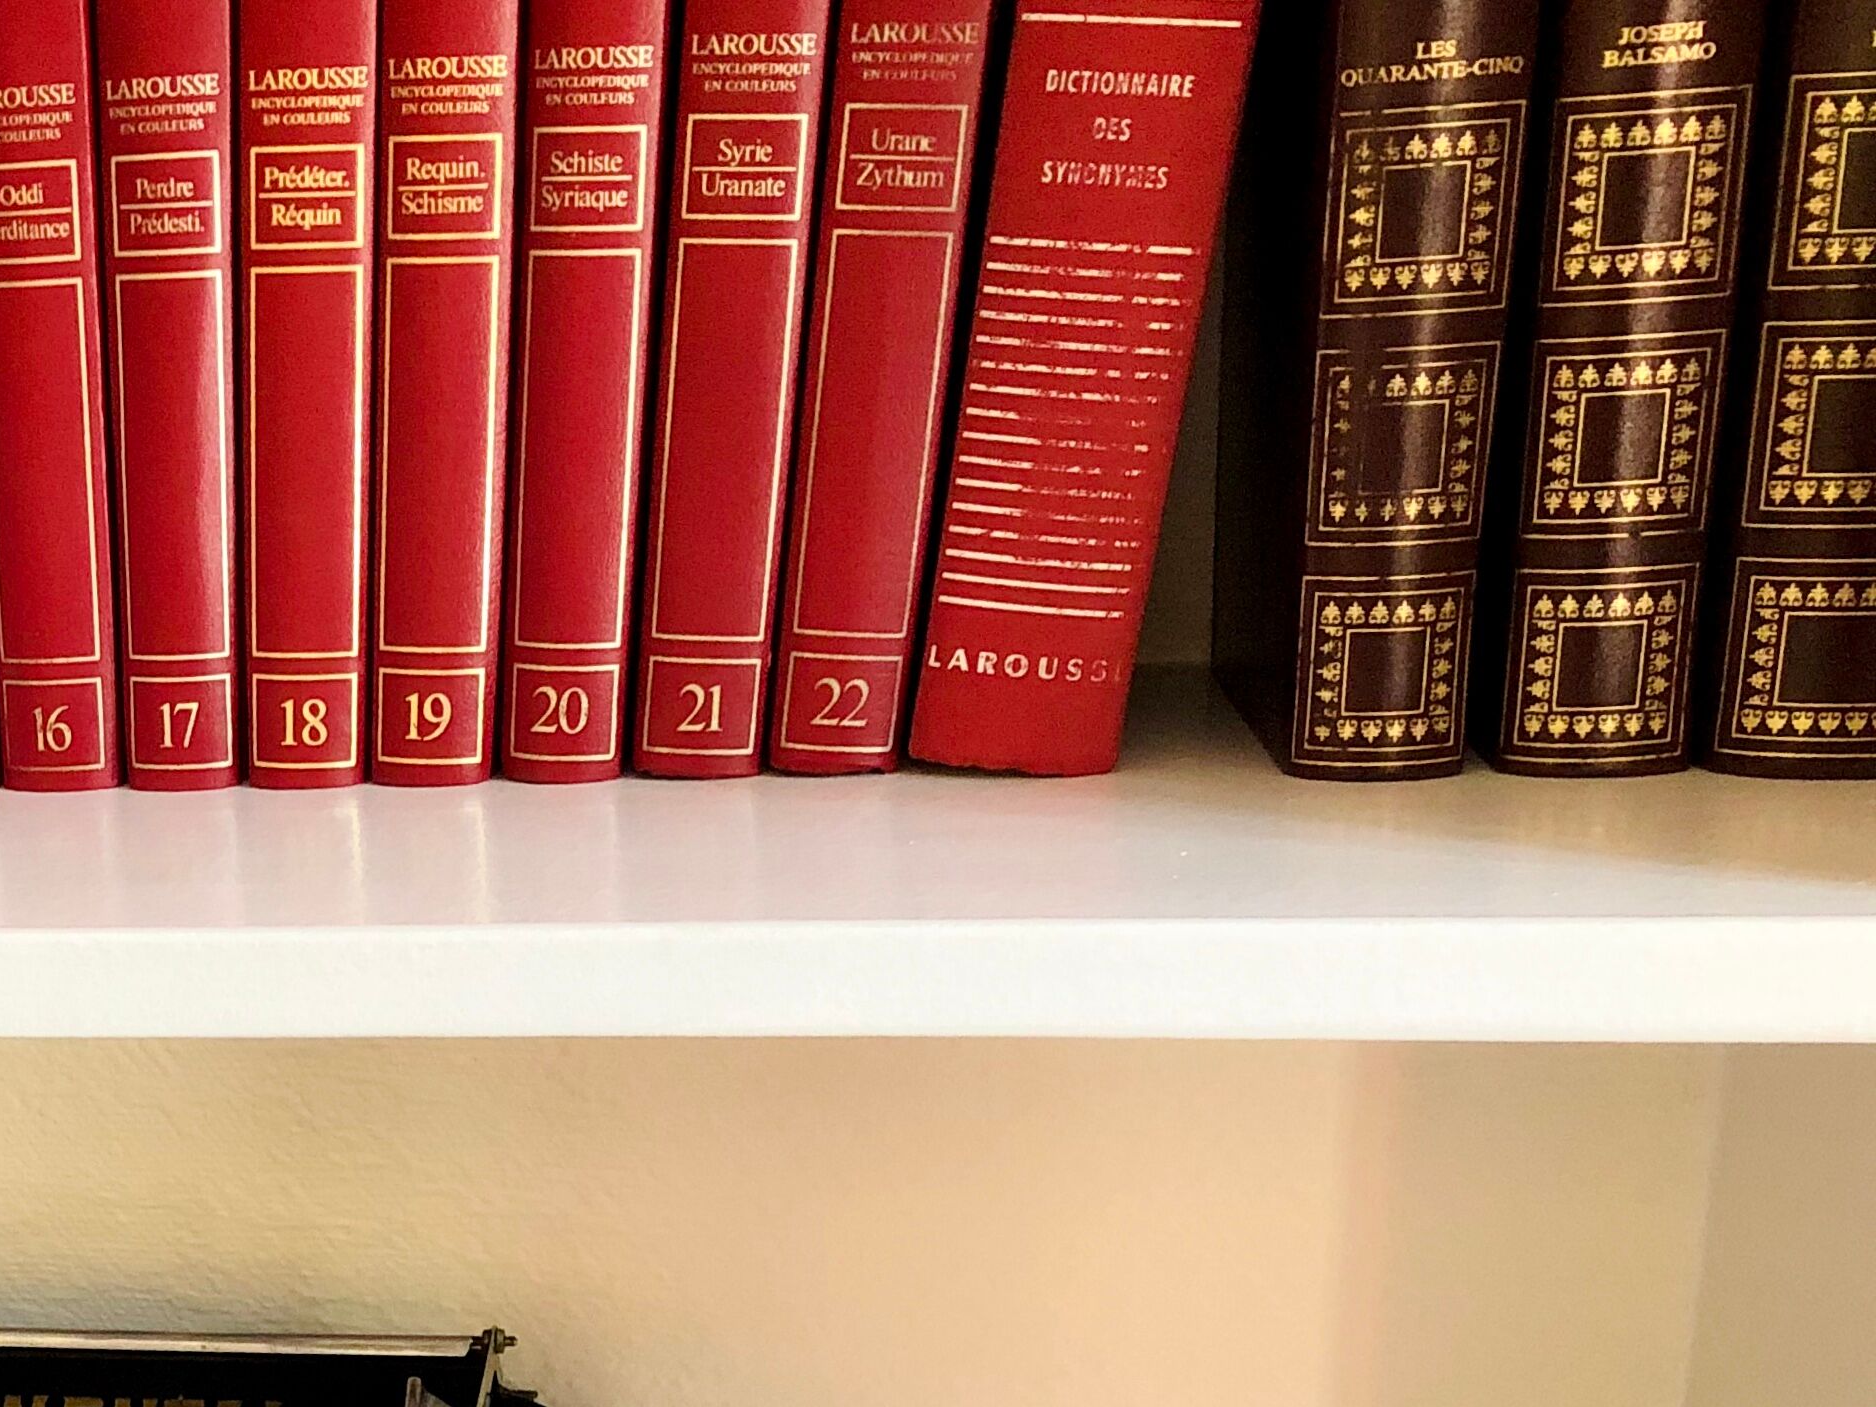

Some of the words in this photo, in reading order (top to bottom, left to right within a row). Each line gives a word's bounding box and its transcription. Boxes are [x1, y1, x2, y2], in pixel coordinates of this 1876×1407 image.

[691, 33, 818, 57] LAROUSSE
[851, 22, 980, 44] LAROUSSE
[1618, 20, 1707, 45] JOSEPH
[534, 45, 654, 70] LAROUSSE
[852, 51, 974, 65] ENCYCLOPEDIQUE
[1415, 40, 1458, 60] LES
[1602, 42, 1717, 69] BALSAMO
[249, 66, 368, 91] LAROUSSE
[388, 54, 508, 80] LAROUSSE
[692, 62, 811, 76] ENCYCLOPEDIQUE
[863, 69, 880, 81] EN
[884, 69, 957, 81] COULEURS
[106, 73, 220, 100] LAROUSSE
[390, 83, 504, 98] ENCYCLOPEDIQUE
[536, 74, 650, 88] ENCYCLOPEDIQUE
[704, 80, 722, 92] EN
[725, 80, 797, 93] COULEURS
[1045, 69, 1196, 98] DICTIONNAIRE
[109, 101, 217, 120] ENCYCLOPEDIQUE
[252, 94, 365, 110] ENCYCLOPEDIQUE
[402, 103, 418, 115] EN
[420, 101, 490, 114] COULEURS
[546, 94, 562, 105] EN
[565, 92, 635, 105] COULEURS
[120, 123, 136, 135] EN
[138, 118, 205, 133] COULEURS
[263, 113, 280, 126] EN
[283, 111, 351, 125] COULEURS
[1093, 117, 1132, 142] DES
[717, 138, 773, 167] Syrie
[872, 127, 936, 153] Urane
[406, 154, 486, 183] Requin.
[550, 150, 623, 175] Schiste
[136, 177, 194, 199] Perdre
[264, 165, 350, 189] Prédéter.
[701, 173, 786, 198] Uranate
[856, 162, 945, 190] Zythum
[1040, 161, 1170, 190] SYNONYMES
[0, 182, 44, 206] Oddi
[401, 190, 484, 216] Schisme
[542, 184, 629, 212] Syriaque
[130, 210, 205, 235] Prédesti.
[271, 202, 342, 230] Réquin
[530, 684, 590, 735] 20
[676, 683, 724, 732] 21
[809, 677, 871, 728] 22
[33, 704, 74, 753] 16
[159, 701, 200, 749] 17
[280, 698, 329, 747] 18
[405, 692, 452, 742] 19
